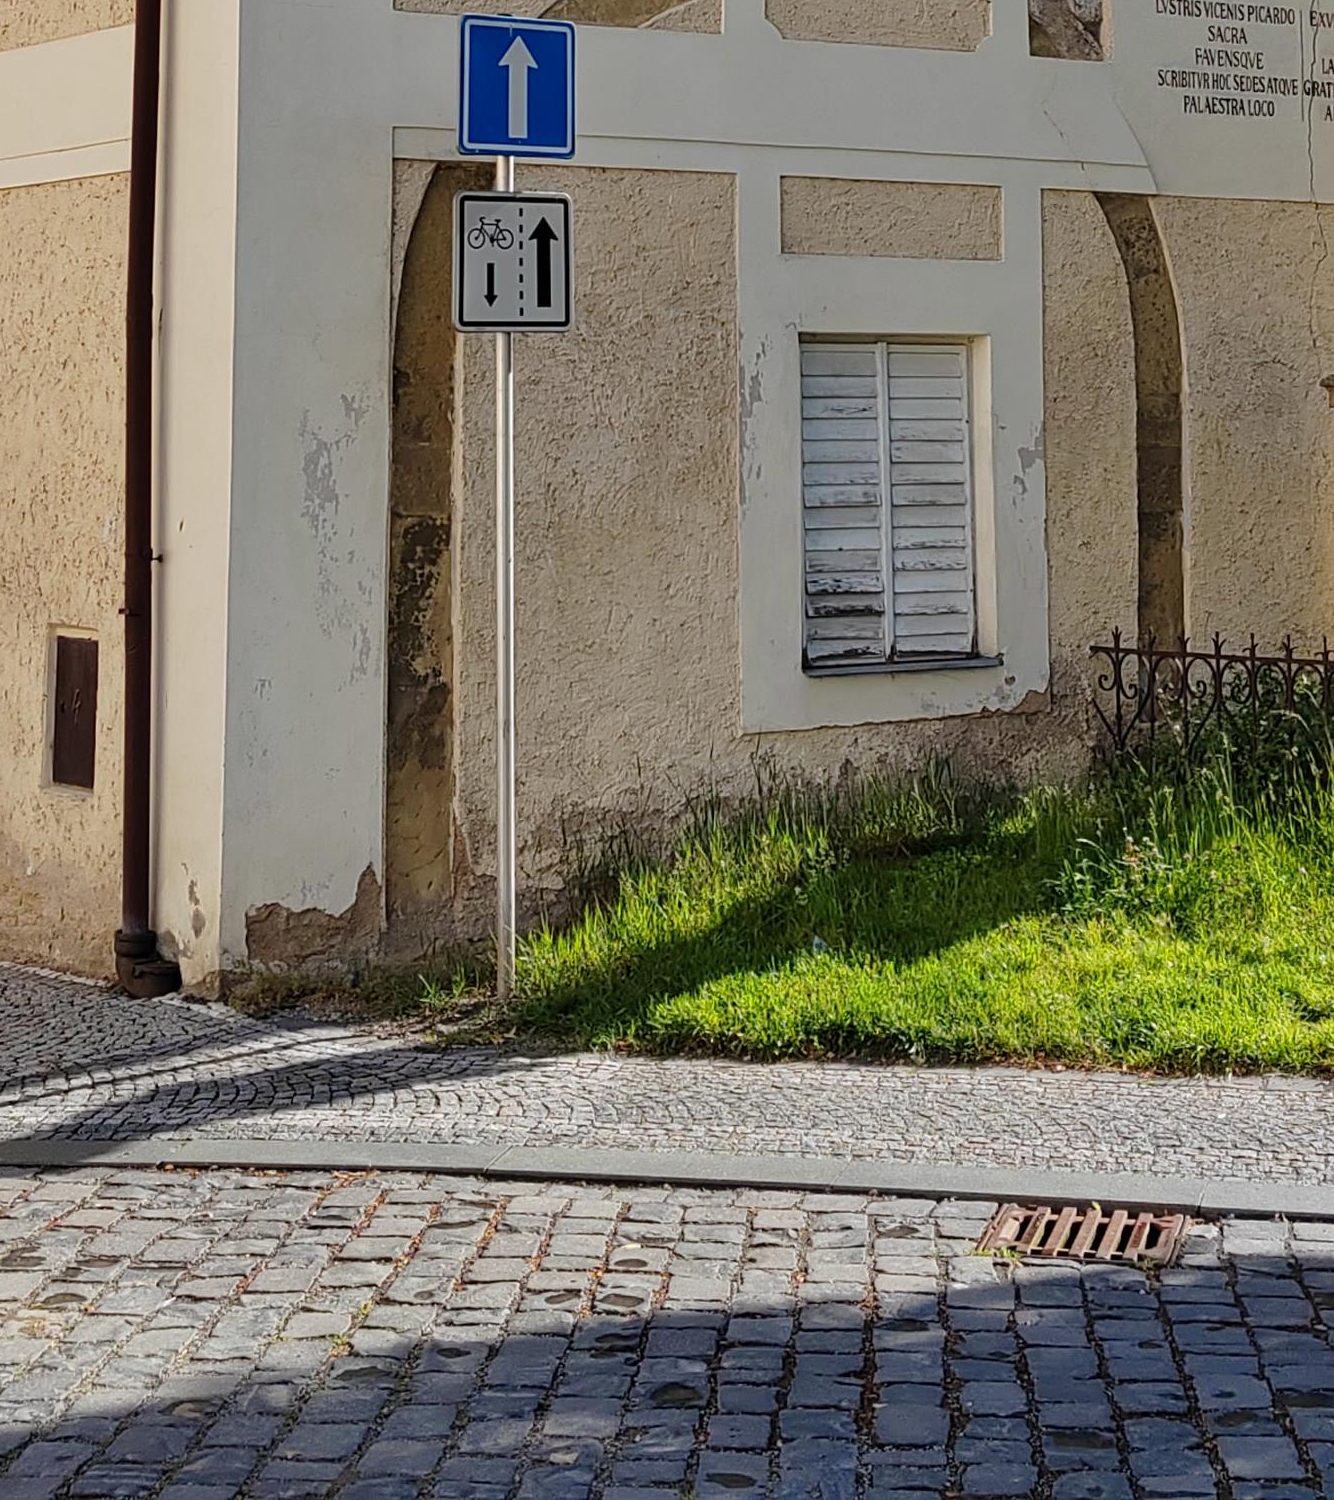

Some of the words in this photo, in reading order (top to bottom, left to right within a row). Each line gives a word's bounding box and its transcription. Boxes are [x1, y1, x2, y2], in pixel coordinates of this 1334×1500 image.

[1203, 0, 1245, 21] VICENIS
[1247, 5, 1296, 25] PICARDO
[1208, 25, 1248, 44] SACRA
[1195, 47, 1264, 70] FAVENSQVE
[1157, 69, 1210, 90] SCRIBITVR
[1212, 73, 1232, 90] HOC
[1233, 74, 1266, 93] SEDES
[1267, 77, 1299, 96] ATQVE
[1183, 95, 1246, 117] PALAESTRA
[1248, 99, 1275, 117] LOCO
